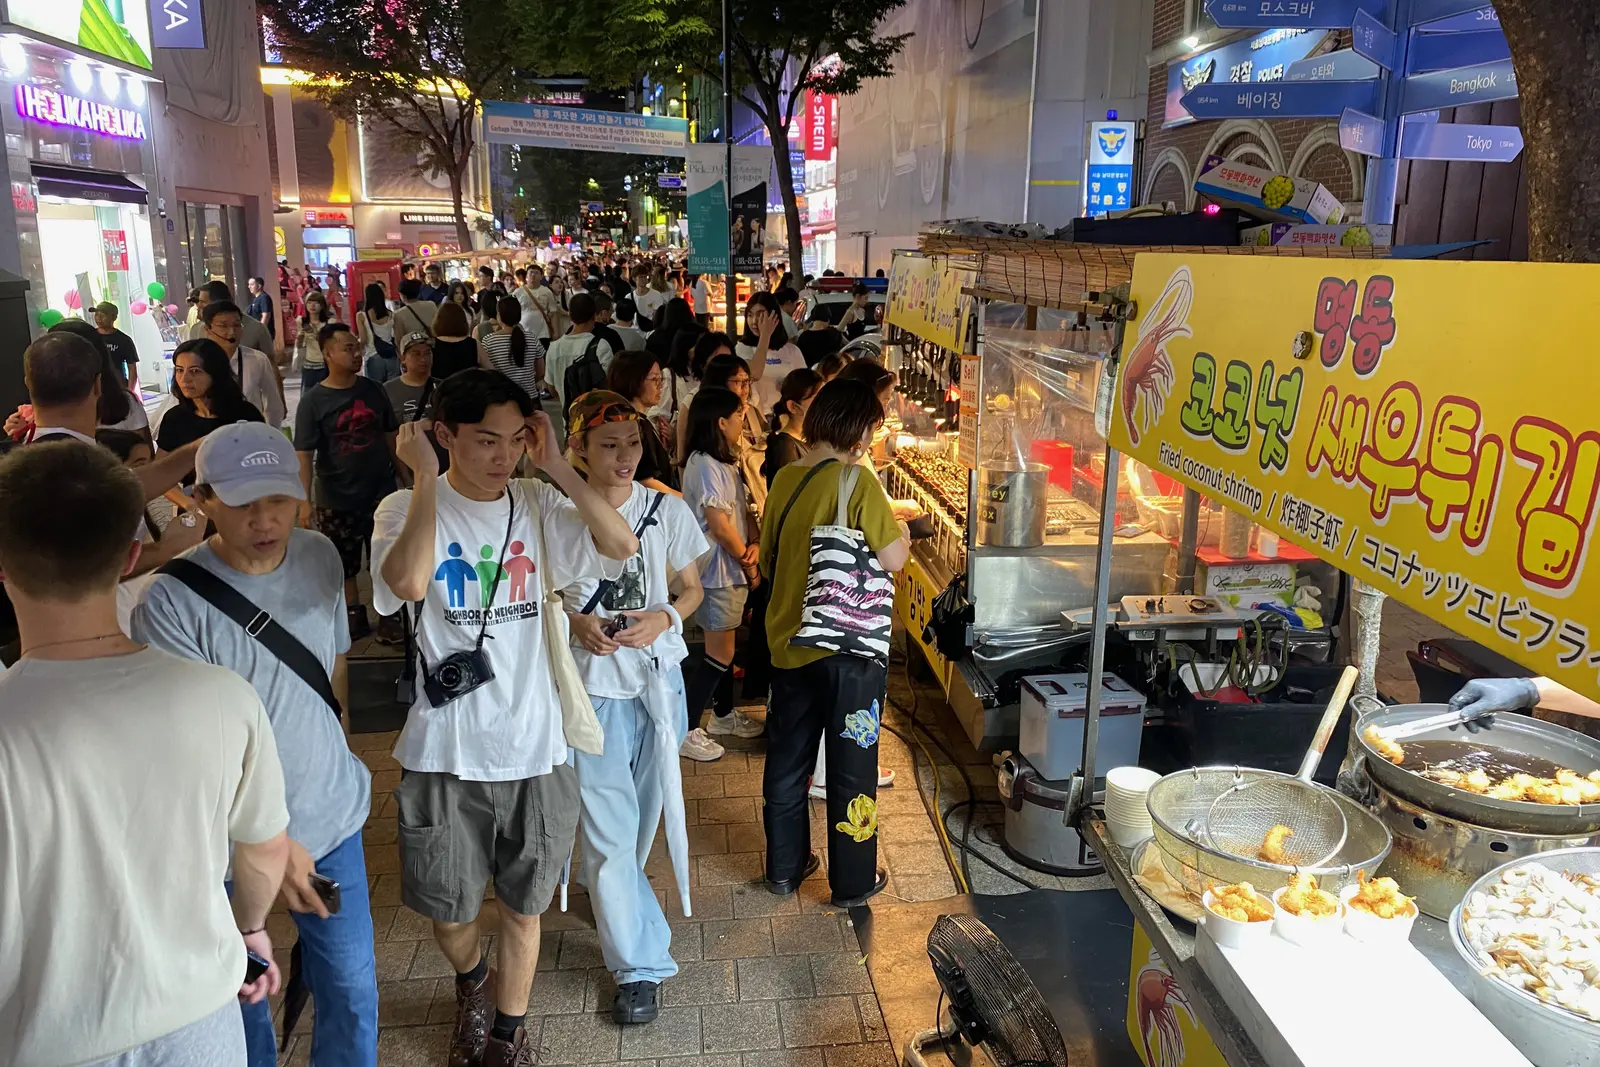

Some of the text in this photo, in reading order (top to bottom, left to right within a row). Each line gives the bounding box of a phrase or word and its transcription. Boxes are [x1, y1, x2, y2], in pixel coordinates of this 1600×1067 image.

[1257, 1, 1315, 19] 모스크바
[1230, 60, 1284, 83] 경찰 POLICE
[1450, 71, 1497, 95] Bangkok
[1209, 96, 1219, 104] km
[1237, 92, 1283, 110] 베이징
[533, 109, 550, 119] 명동
[581, 113, 596, 122] 거리
[812, 105, 826, 151] SAEM
[1467, 135, 1493, 152] Tokyo
[403, 214, 423, 222] LINE
[424, 215, 453, 223] FRIENDS
[103, 239, 127, 254] SALE
[1313, 274, 1397, 376] 명동
[963, 364, 976, 380] Self
[240, 453, 279, 467] emis
[1180, 352, 1600, 591] 코코넛 새우튀김
[1158, 441, 1181, 470] Fried
[1181, 458, 1223, 494] coconut
[1223, 470, 1263, 514] shrimp
[1280, 493, 1343, 552] 炸椰子虾
[443, 607, 481, 620] NEIGHBOR
[494, 600, 538, 618] NEIGHBOR
